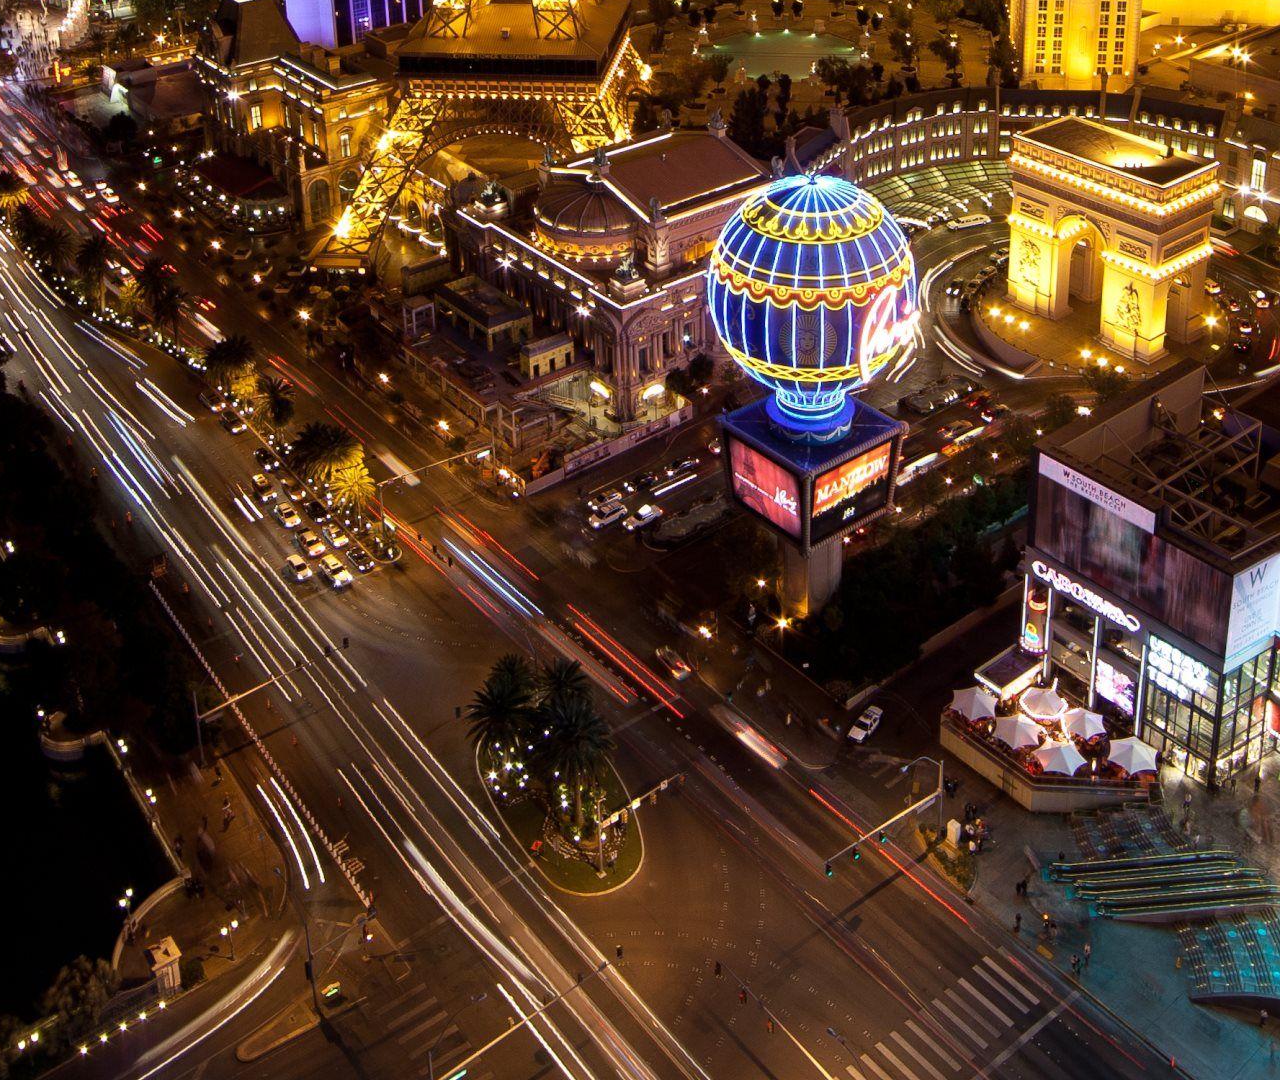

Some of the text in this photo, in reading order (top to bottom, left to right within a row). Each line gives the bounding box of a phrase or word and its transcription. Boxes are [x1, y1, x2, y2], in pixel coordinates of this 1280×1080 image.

[1063, 468, 1127, 509] W SOUTH BEACH
[1249, 562, 1268, 589] W
